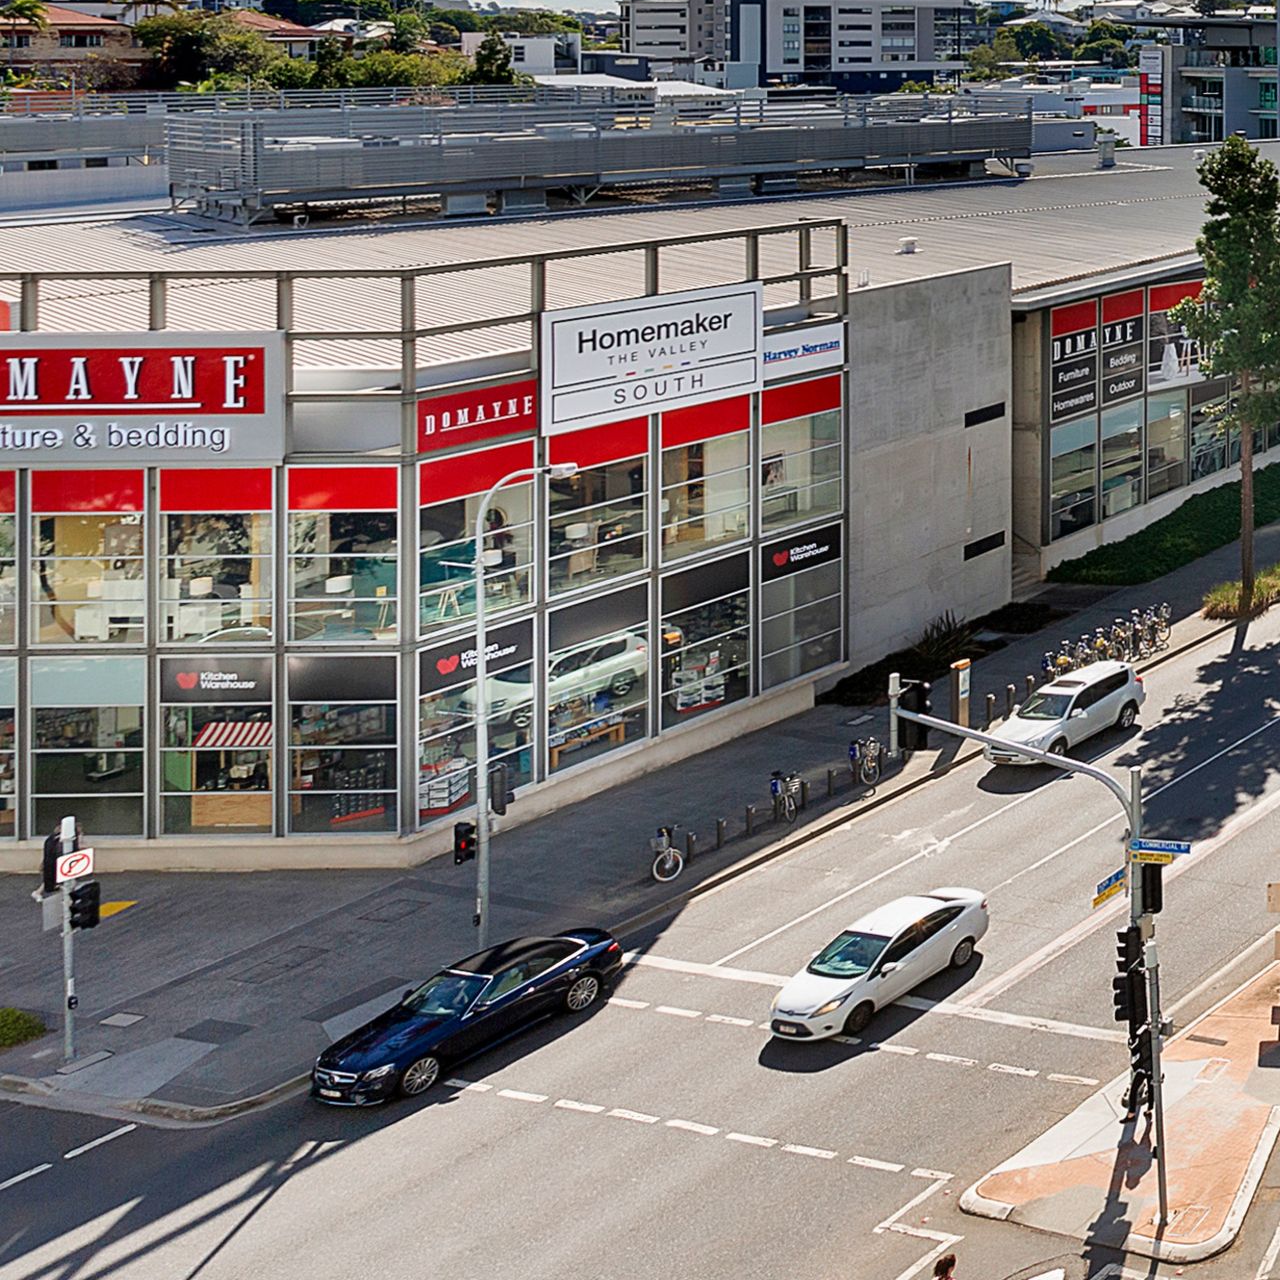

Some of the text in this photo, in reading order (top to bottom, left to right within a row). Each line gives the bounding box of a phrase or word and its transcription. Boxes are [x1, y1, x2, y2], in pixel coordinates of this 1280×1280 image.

[577, 310, 733, 354] Homemaker
[1053, 322, 1134, 362] DOMAYNE
[608, 339, 709, 365] THE VALLEY
[763, 340, 840, 361] Harvey Norman
[1109, 353, 1136, 369] Bedding
[6, 356, 245, 408] MAYNE
[1058, 365, 1090, 384] Furniture
[613, 374, 705, 404] SOUTH
[1109, 378, 1136, 395] Outdoor
[1053, 391, 1095, 412] Homewares
[425, 395, 534, 435] DOMAYNE
[73, 422, 97, 450] &
[107, 421, 231, 453] bedding
[461, 643, 499, 661] Kiten
[200, 671, 238, 680] Kitchen
[200, 680, 256, 689] Warehouse
